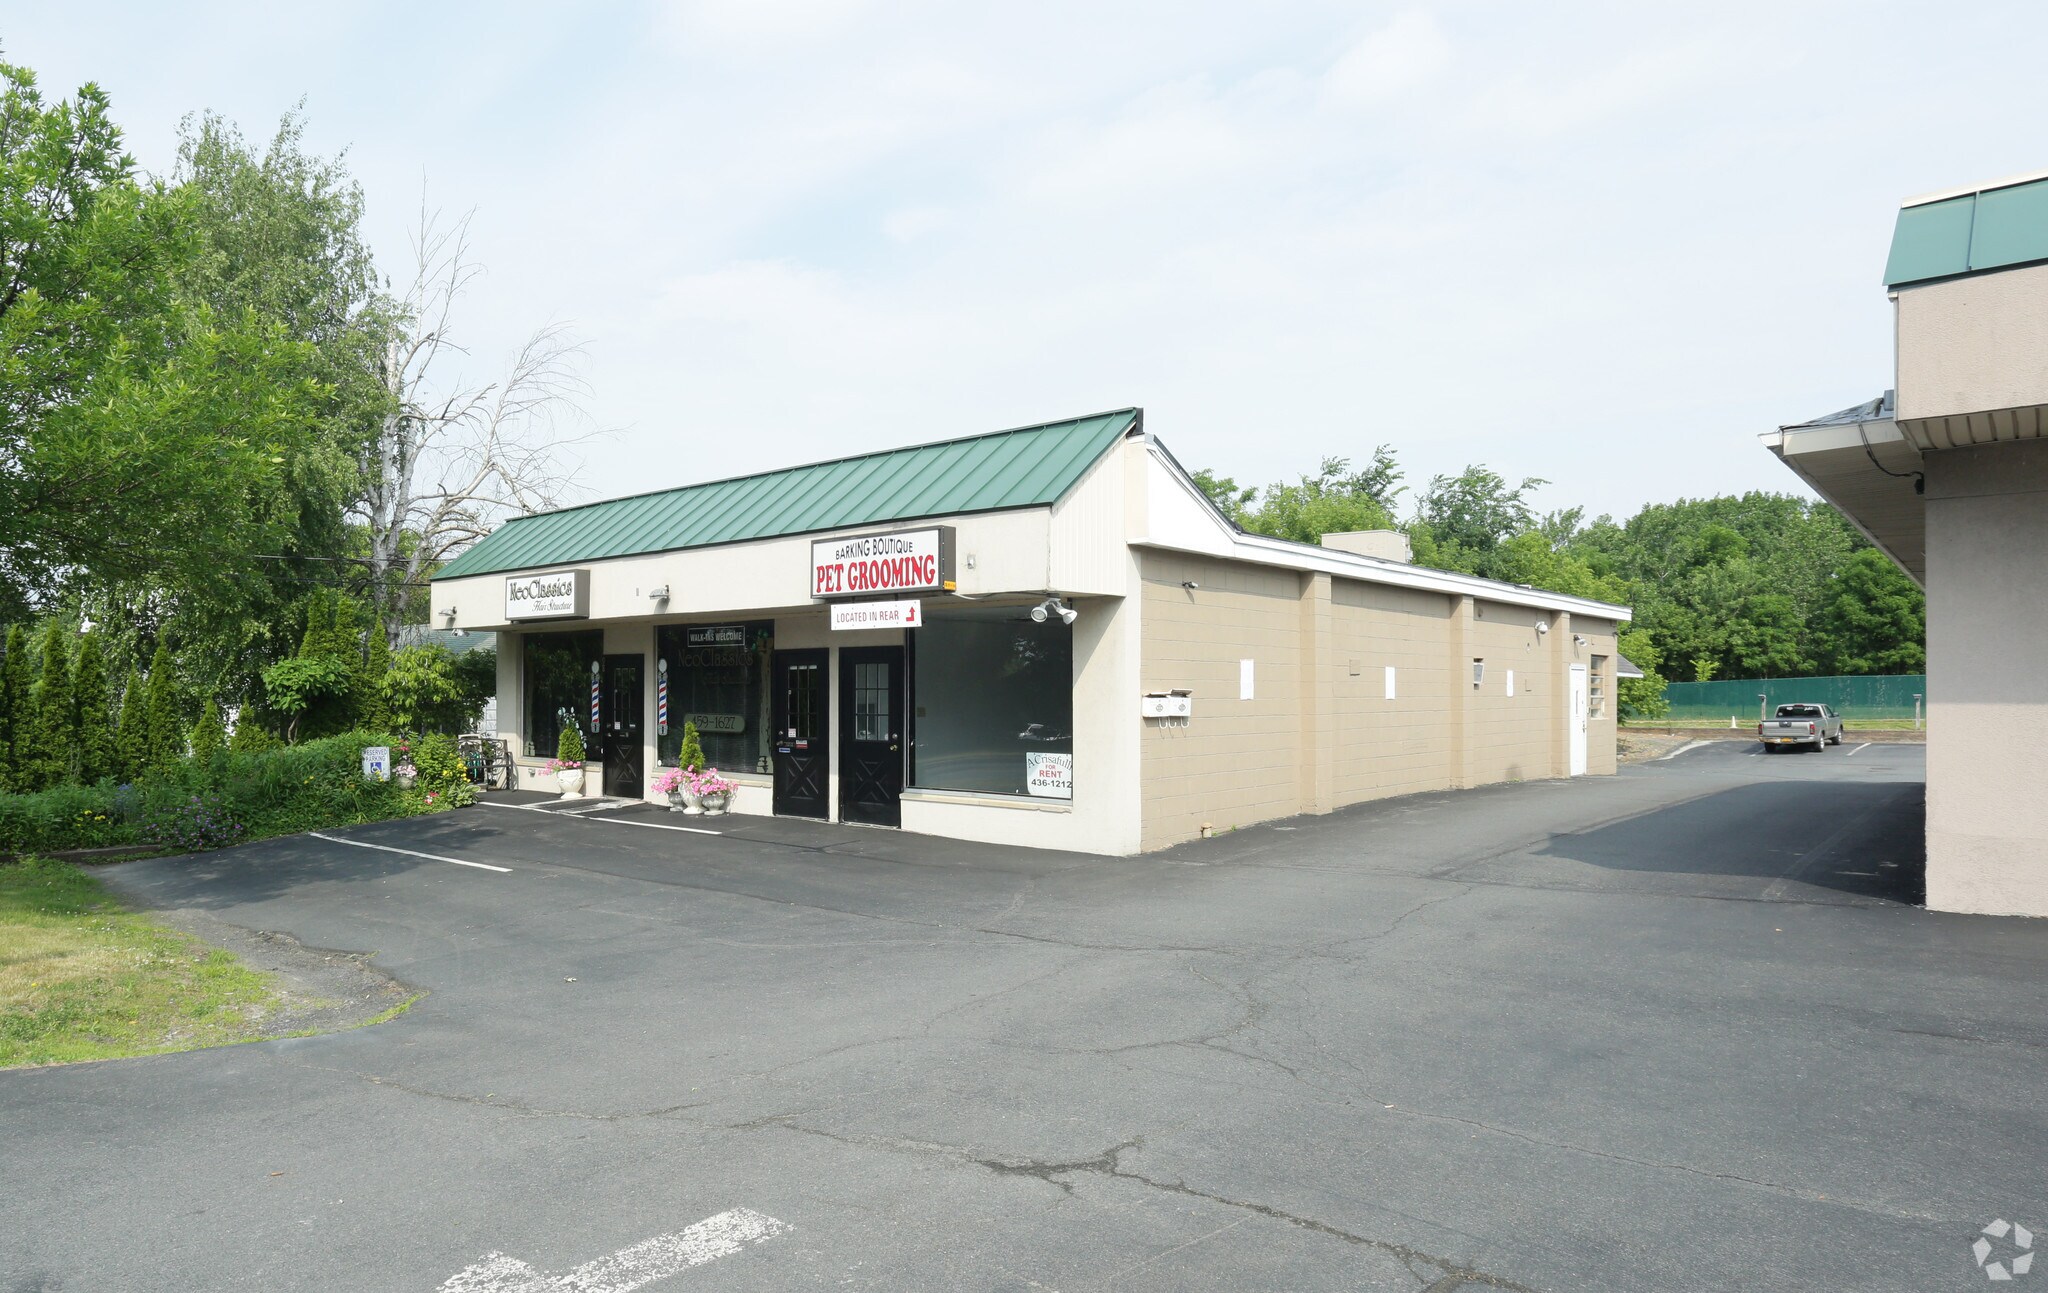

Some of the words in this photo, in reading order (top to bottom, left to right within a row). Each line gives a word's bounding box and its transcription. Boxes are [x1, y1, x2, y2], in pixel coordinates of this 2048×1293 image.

[835, 540, 870, 560] BARKING
[872, 538, 913, 556] BOUTIQUE
[816, 563, 844, 593] PET
[847, 554, 936, 591] GROOMING
[510, 578, 573, 601] NeoClassics
[836, 612, 867, 623] LOCATED
[869, 611, 878, 622] IN
[879, 610, 899, 621] REAR
[715, 631, 742, 641] WELCOME
[1039, 770, 1062, 778] RENT
[1031, 779, 1072, 788] 436-1212
